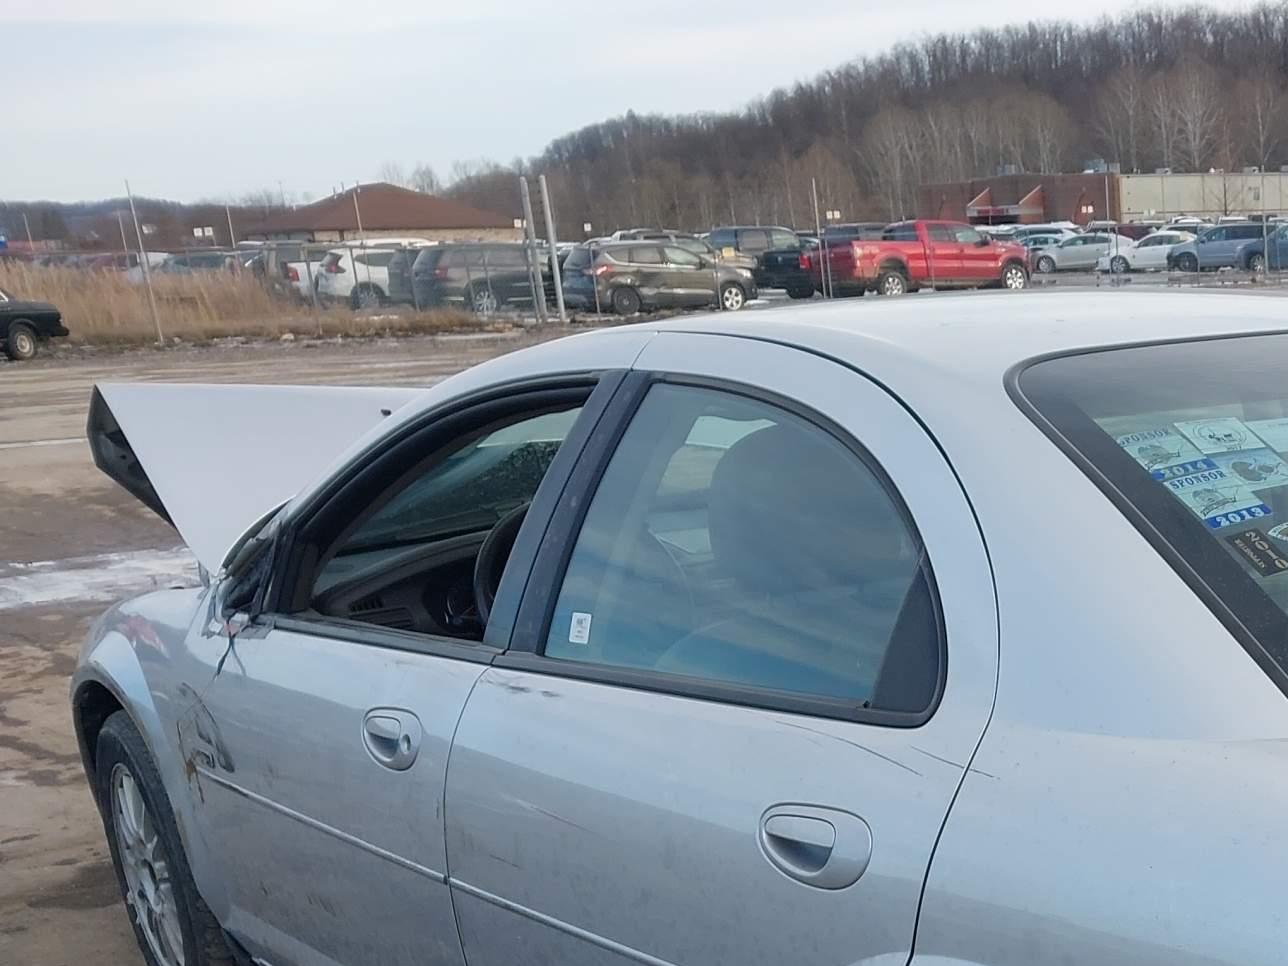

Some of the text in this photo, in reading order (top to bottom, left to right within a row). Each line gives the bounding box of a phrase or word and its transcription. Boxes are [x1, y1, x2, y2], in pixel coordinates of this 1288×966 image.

[1120, 428, 1169, 446] SPONSOR
[1162, 460, 1206, 479] 2014
[1169, 469, 1227, 490] SPONSOR
[1215, 507, 1265, 527] 2013
[1245, 531, 1288, 569] 2010
